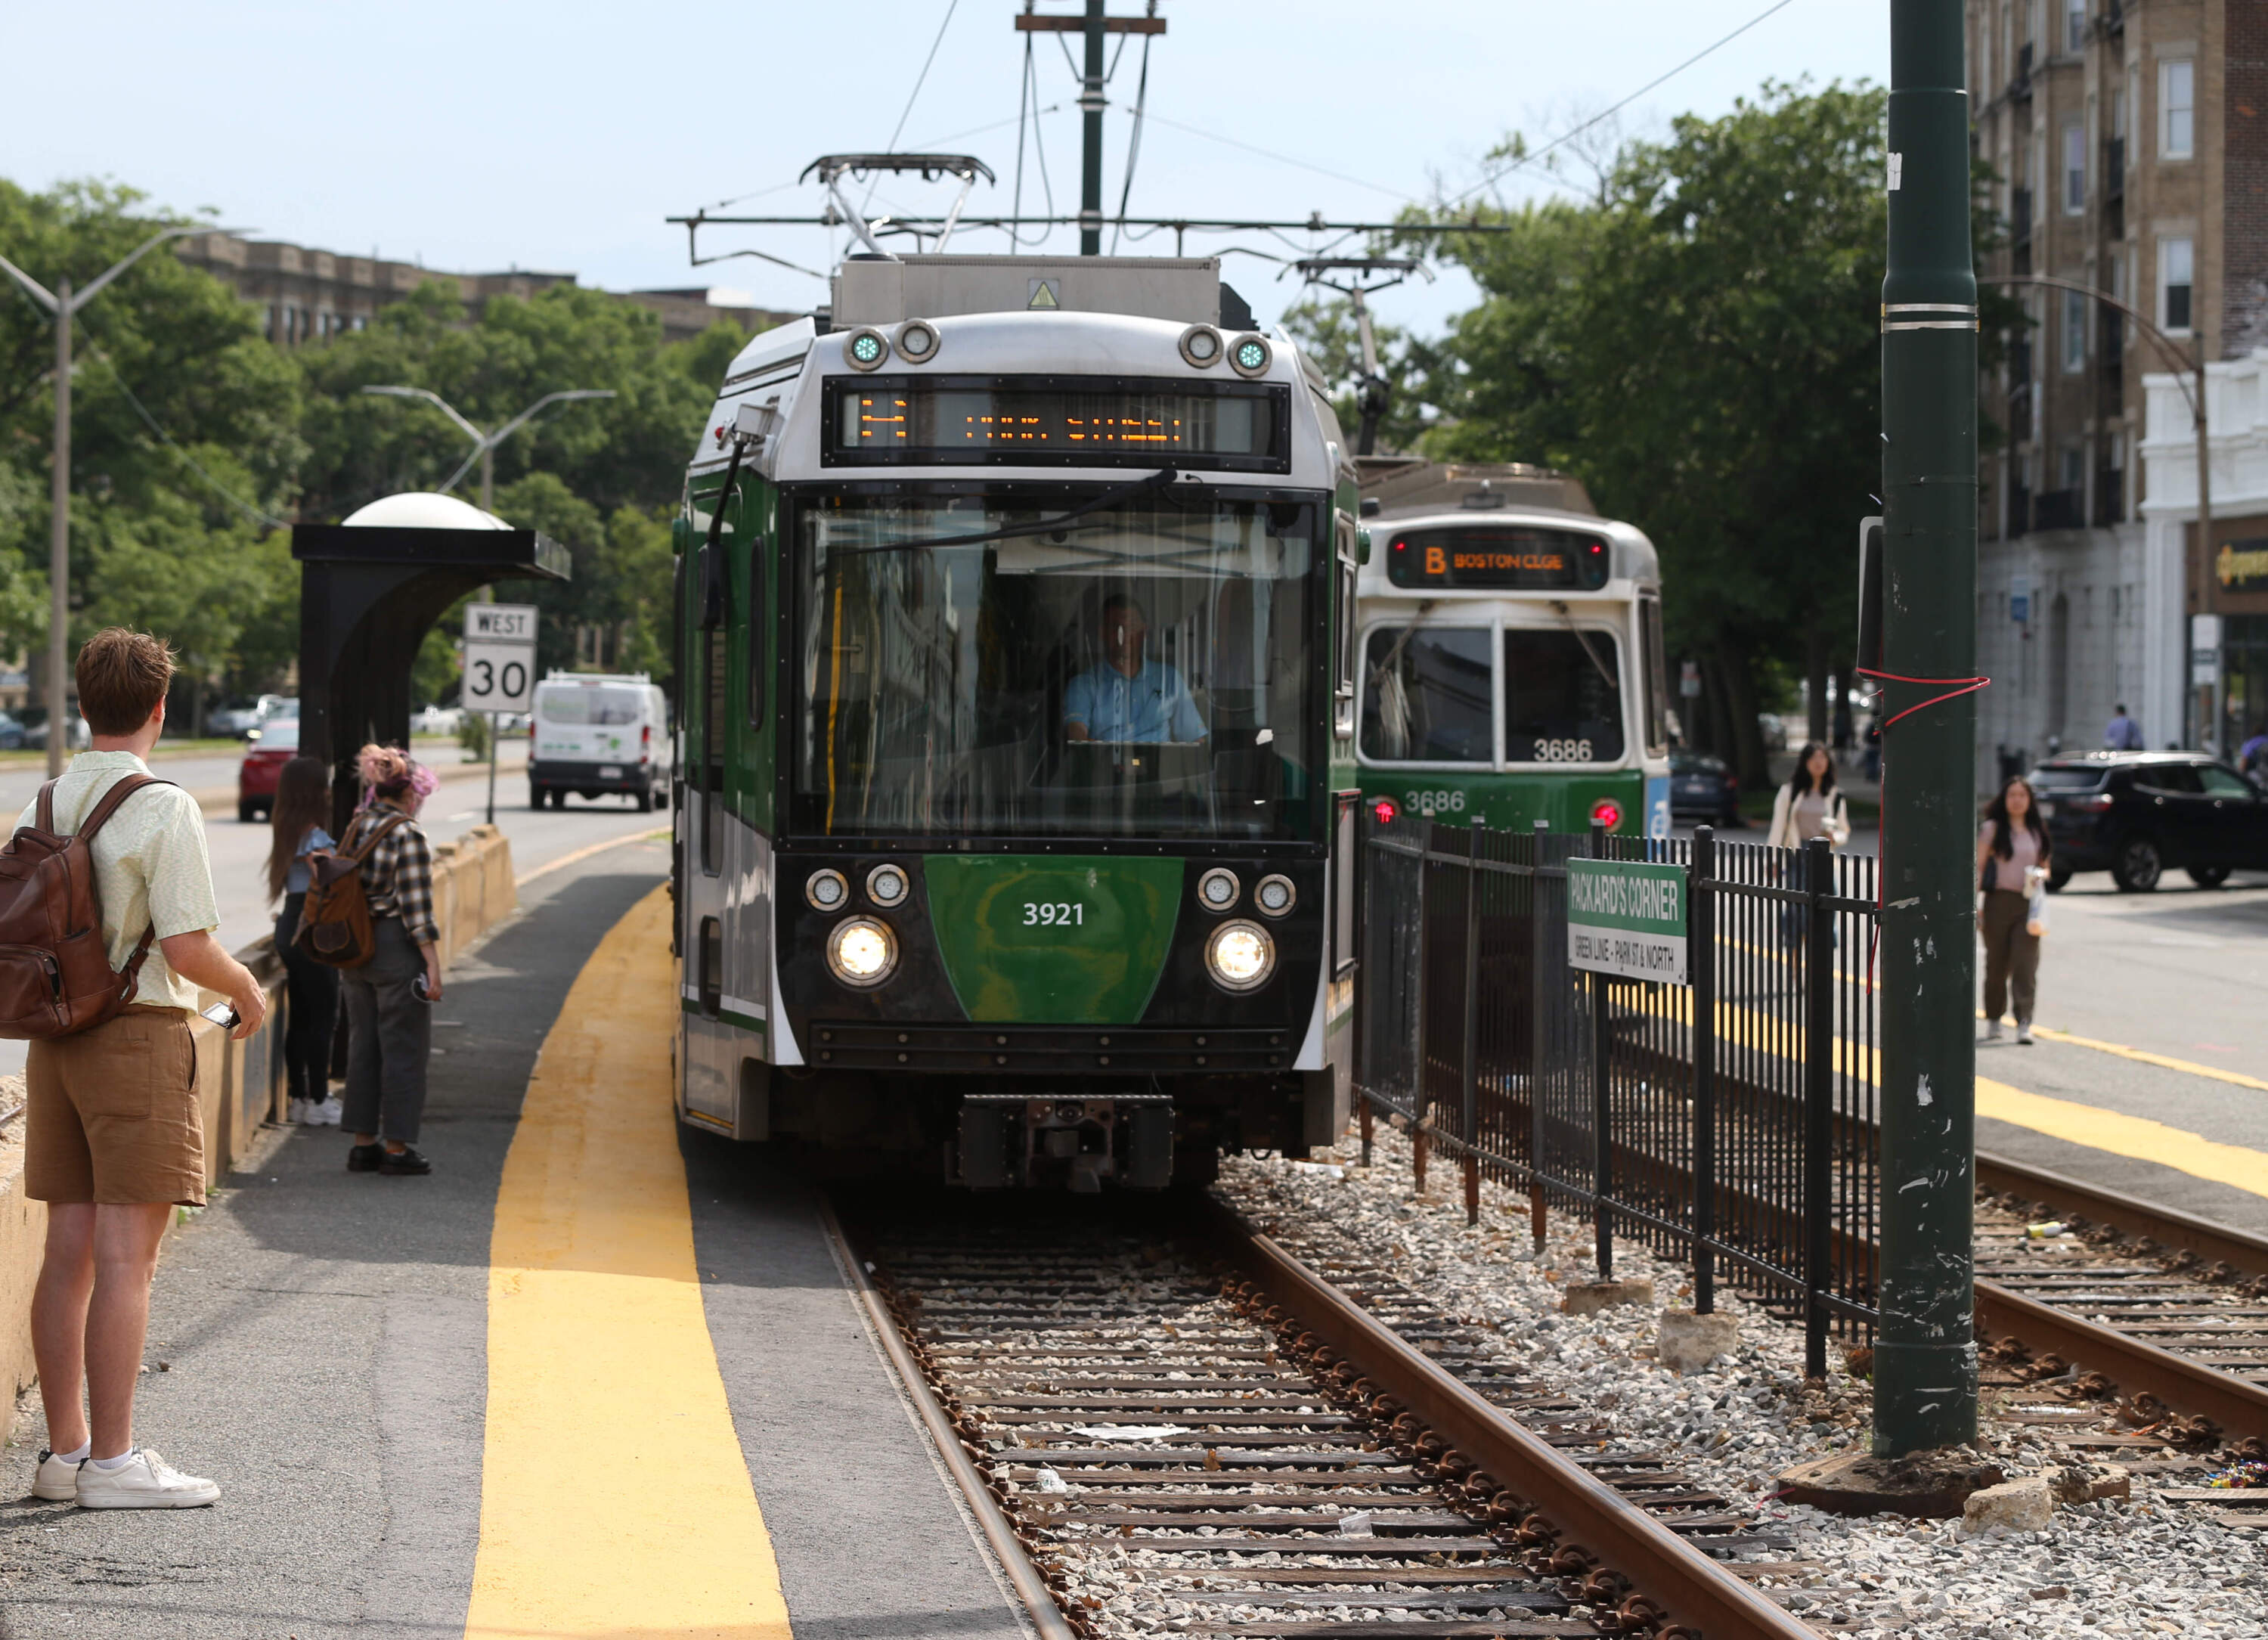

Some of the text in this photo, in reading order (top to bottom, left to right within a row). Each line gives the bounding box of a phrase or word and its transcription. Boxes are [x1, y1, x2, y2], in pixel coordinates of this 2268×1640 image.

[1426, 547, 1563, 575] B BOSTON CLGE
[476, 612, 526, 633] WEST
[471, 659, 526, 698] 30
[1534, 739, 1592, 761] 3686
[1405, 790, 1464, 811] 3686
[1571, 872, 1678, 921] PACKARD'S CORNER
[1023, 903, 1083, 925] 3921
[1594, 937, 1609, 962] LINE
[1615, 940, 1631, 965] PARK
[1647, 944, 1674, 972] NORTH
